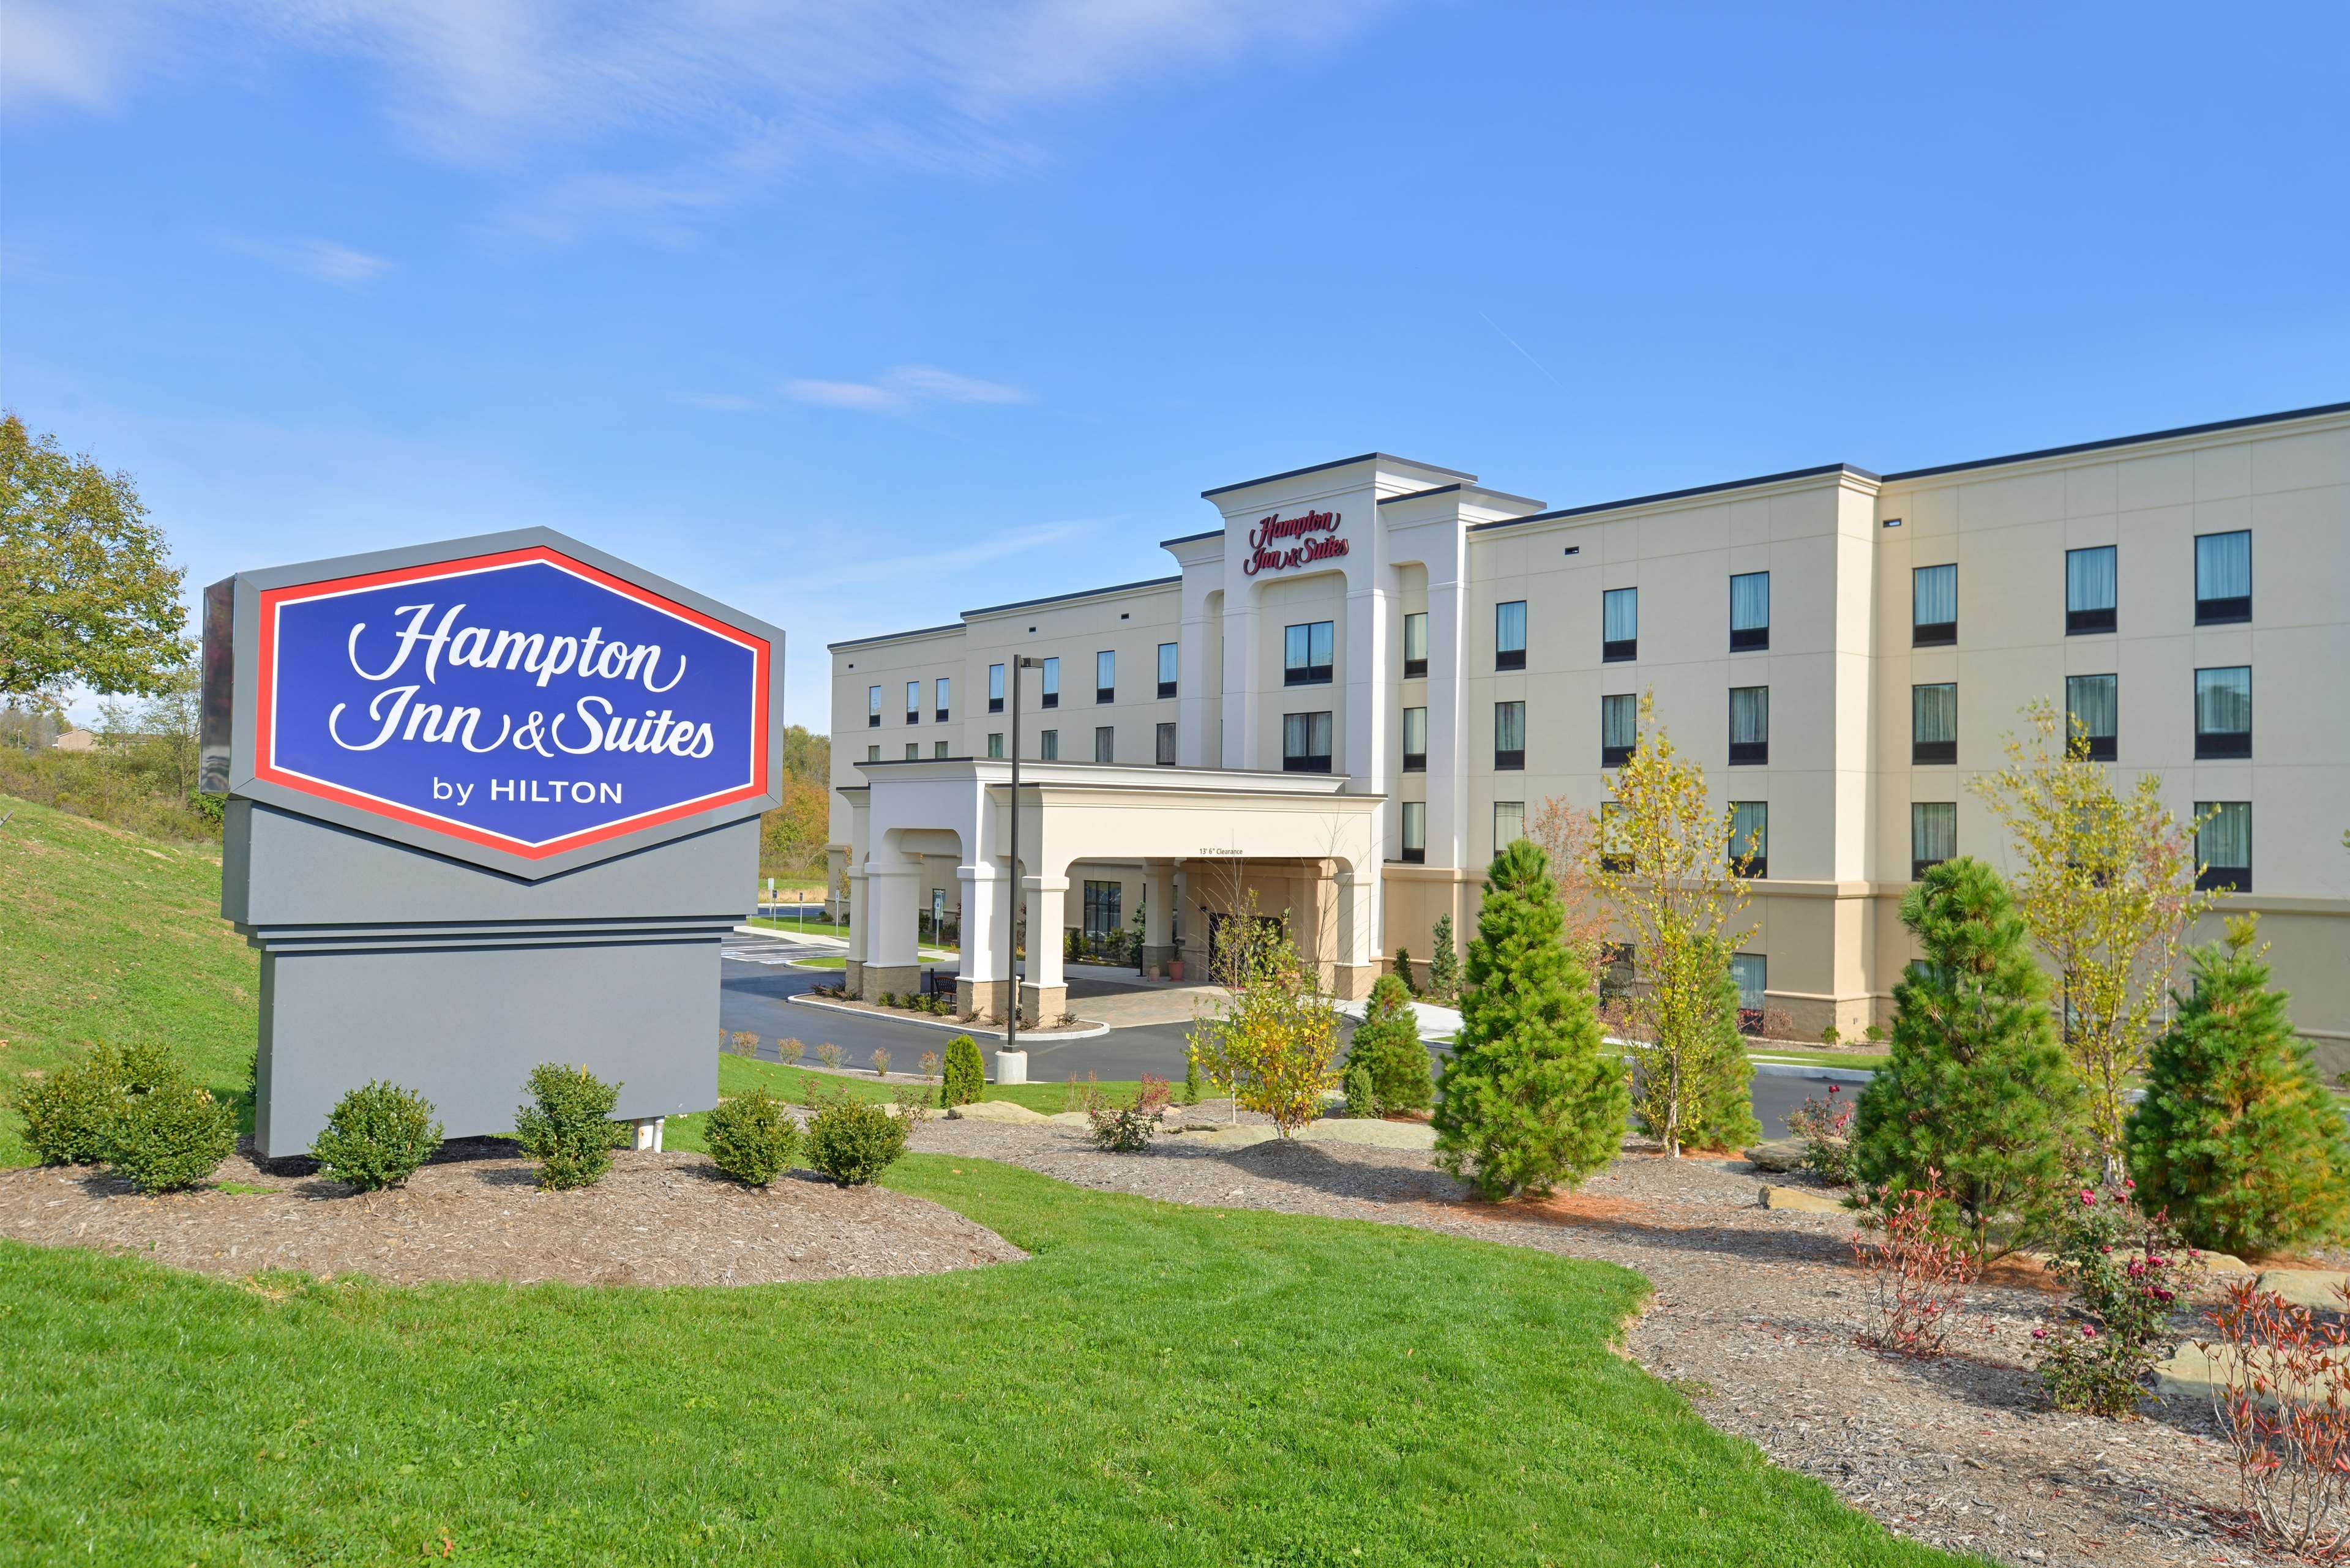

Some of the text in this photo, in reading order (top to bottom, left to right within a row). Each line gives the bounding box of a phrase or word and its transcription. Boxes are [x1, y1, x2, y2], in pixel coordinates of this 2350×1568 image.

[1249, 510, 1341, 549] Hampton
[1243, 535, 1349, 576] Inn & Suites
[348, 603, 686, 693] Hampton
[329, 685, 714, 759] Inn & Suites
[433, 777, 623, 806] by HILTON
